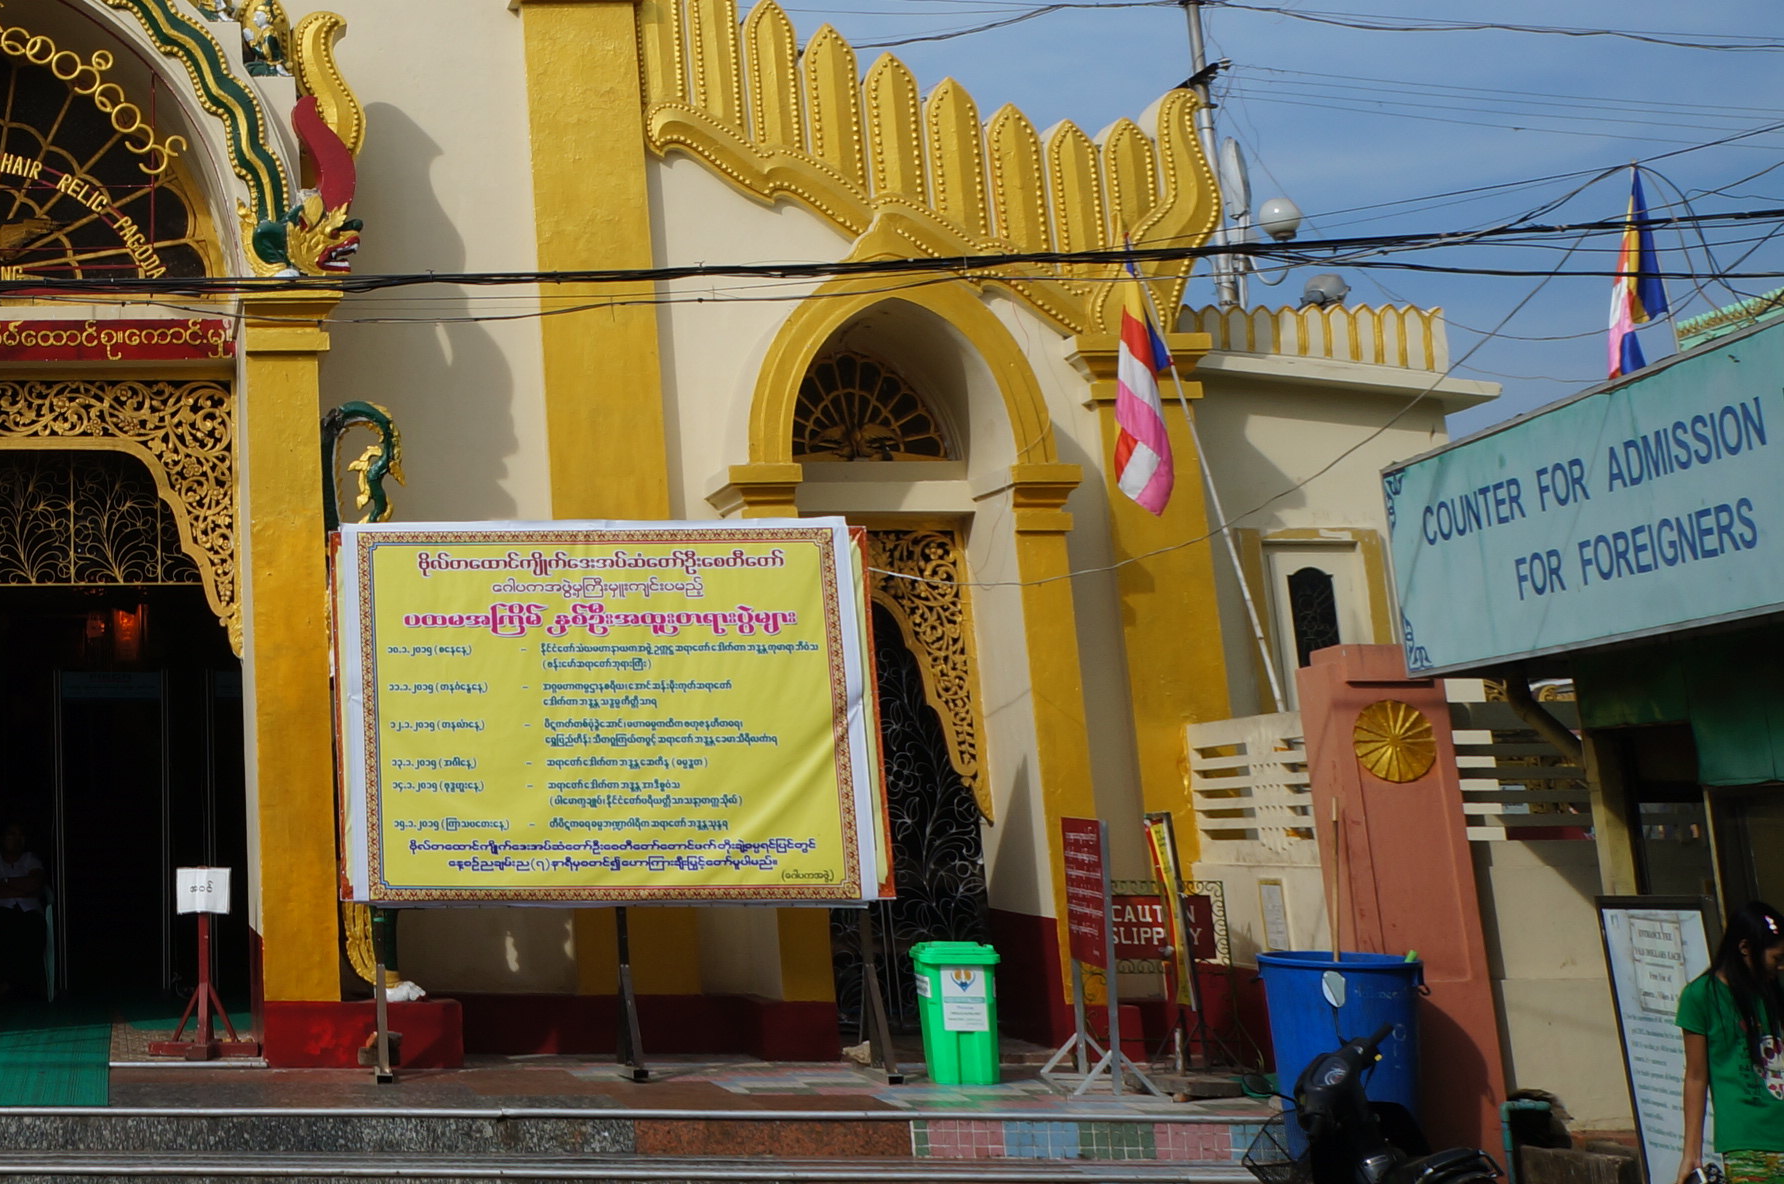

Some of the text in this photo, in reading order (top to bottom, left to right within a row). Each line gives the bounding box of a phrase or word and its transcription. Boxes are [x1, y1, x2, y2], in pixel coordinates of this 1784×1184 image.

[0, 154, 43, 180] HAIR
[56, 173, 108, 213] RELIC
[112, 216, 167, 279] PAGODA
[1422, 396, 1767, 546] COUNTER FOR ADMISSION
[1514, 498, 1758, 601] FOR FOREIGNERS
[1111, 904, 1196, 924] CAUTN
[1112, 926, 1203, 945] SLIPPY
